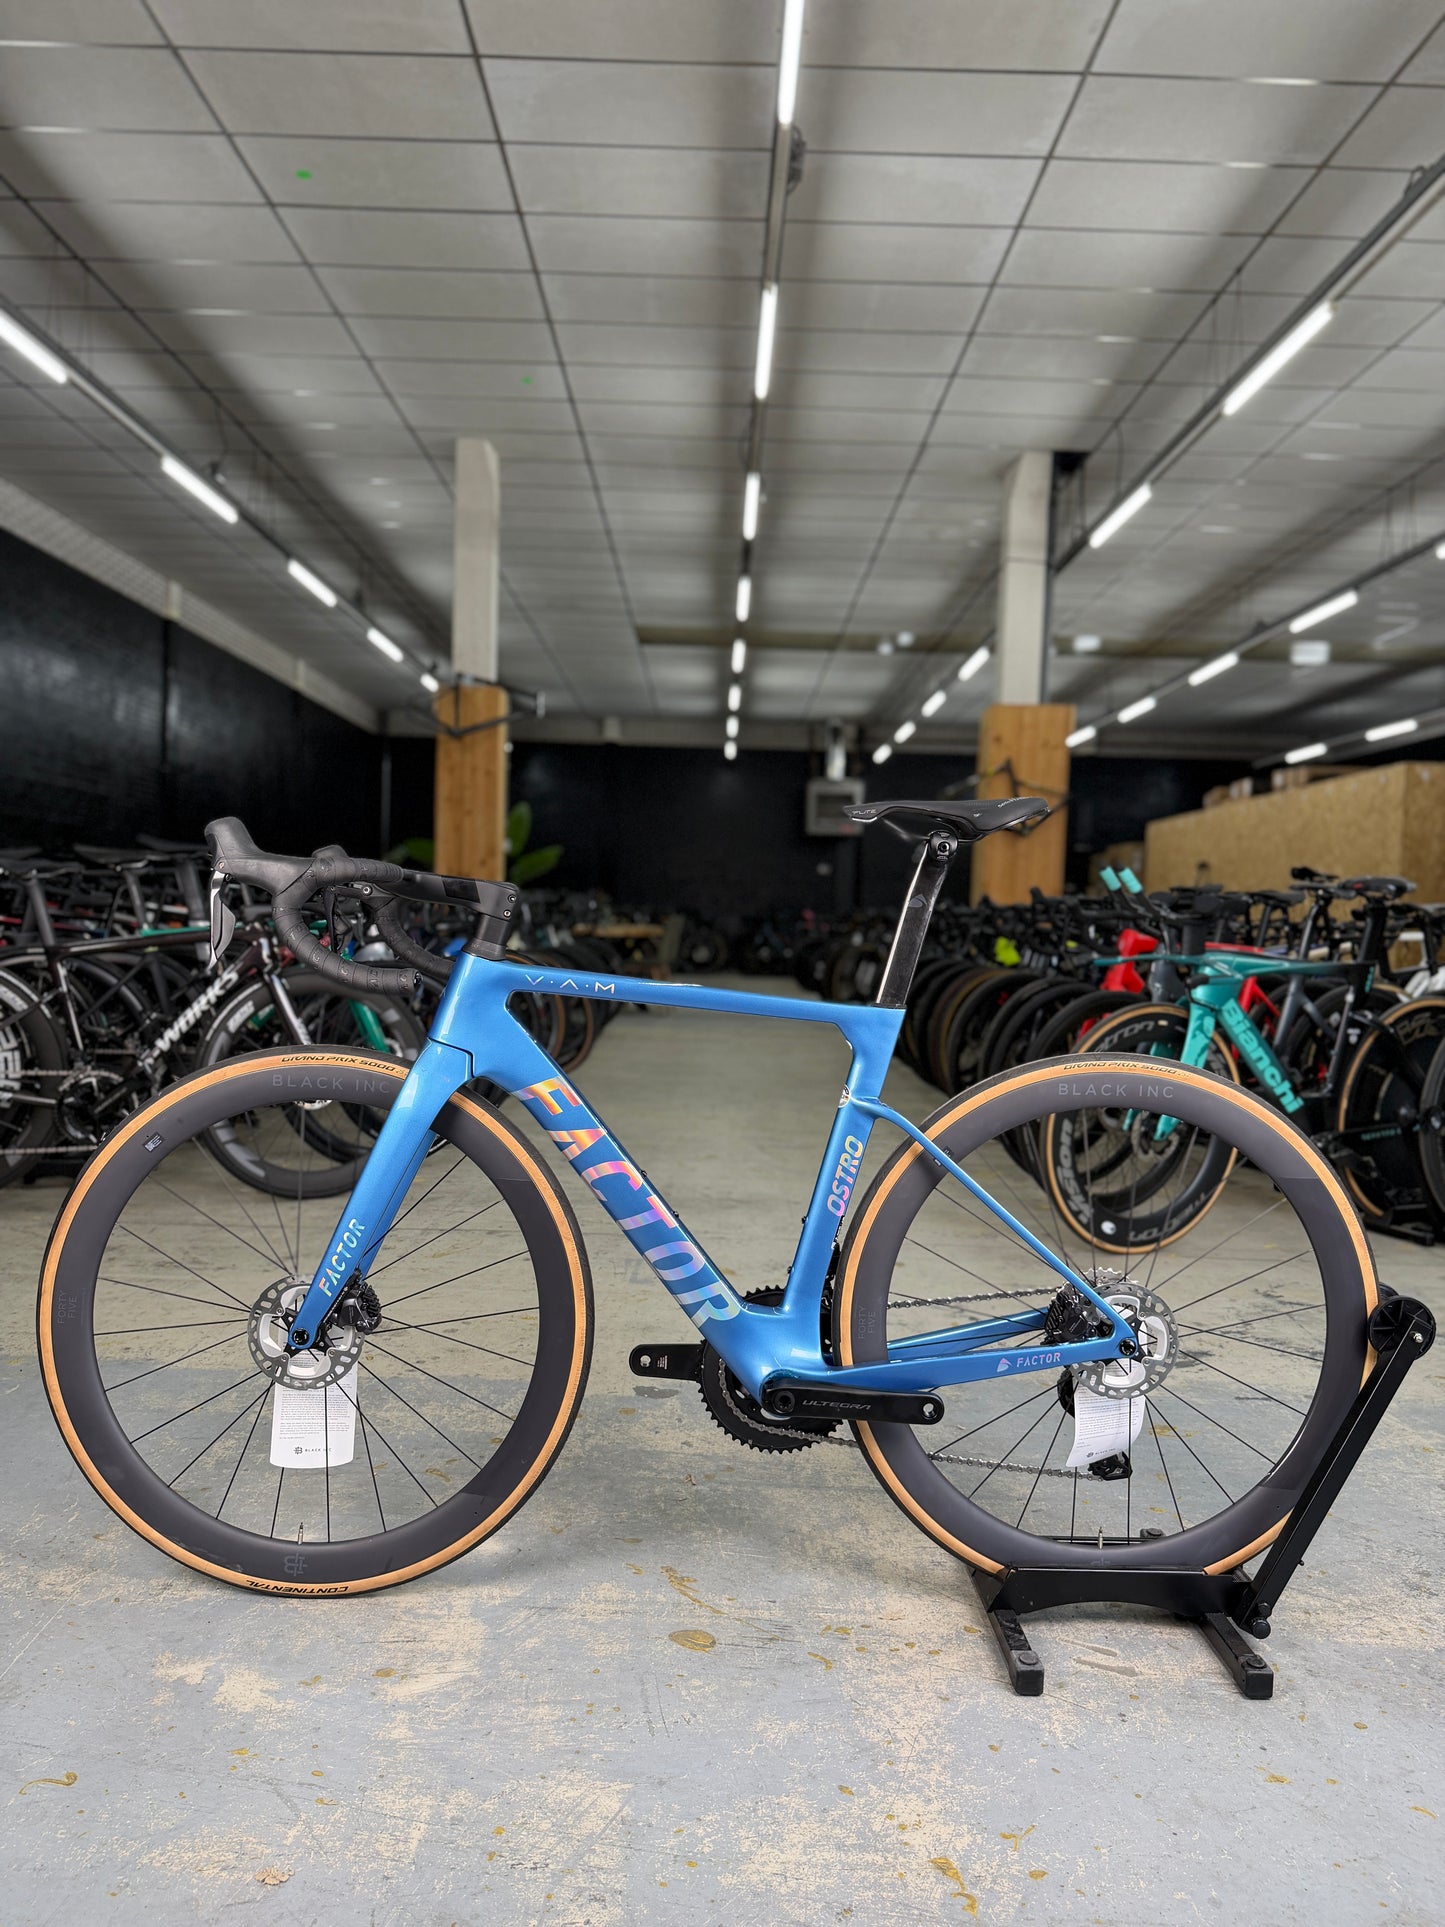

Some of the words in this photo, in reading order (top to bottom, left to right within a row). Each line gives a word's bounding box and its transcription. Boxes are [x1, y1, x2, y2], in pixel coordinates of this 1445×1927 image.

[281, 1055, 324, 1063] GRAND
[326, 1056, 359, 1064] PRIX
[359, 1059, 397, 1072] 5000
[1222, 998, 1305, 1115] Bianchi
[1063, 1062, 1106, 1071] GRAND
[1141, 1064, 1177, 1075] 5000
[272, 1074, 344, 1090] BLACK
[355, 1079, 390, 1093] INC
[1058, 1083, 1127, 1097] BLACK
[1139, 1085, 1174, 1099] INC
[827, 1135, 864, 1217] OSTRO
[514, 1075, 741, 1330] FACTOR
[319, 1218, 367, 1297] FACTOR
[57, 1289, 67, 1324] FORTY
[67, 1296, 78, 1319] FIVE
[857, 1304, 867, 1339] FORTY
[867, 1311, 876, 1334] FIVE
[1016, 1352, 1061, 1368] FACTOR
[802, 1399, 872, 1410] ULTEGRA
[246, 1580, 349, 1594] CONTINENTAL
